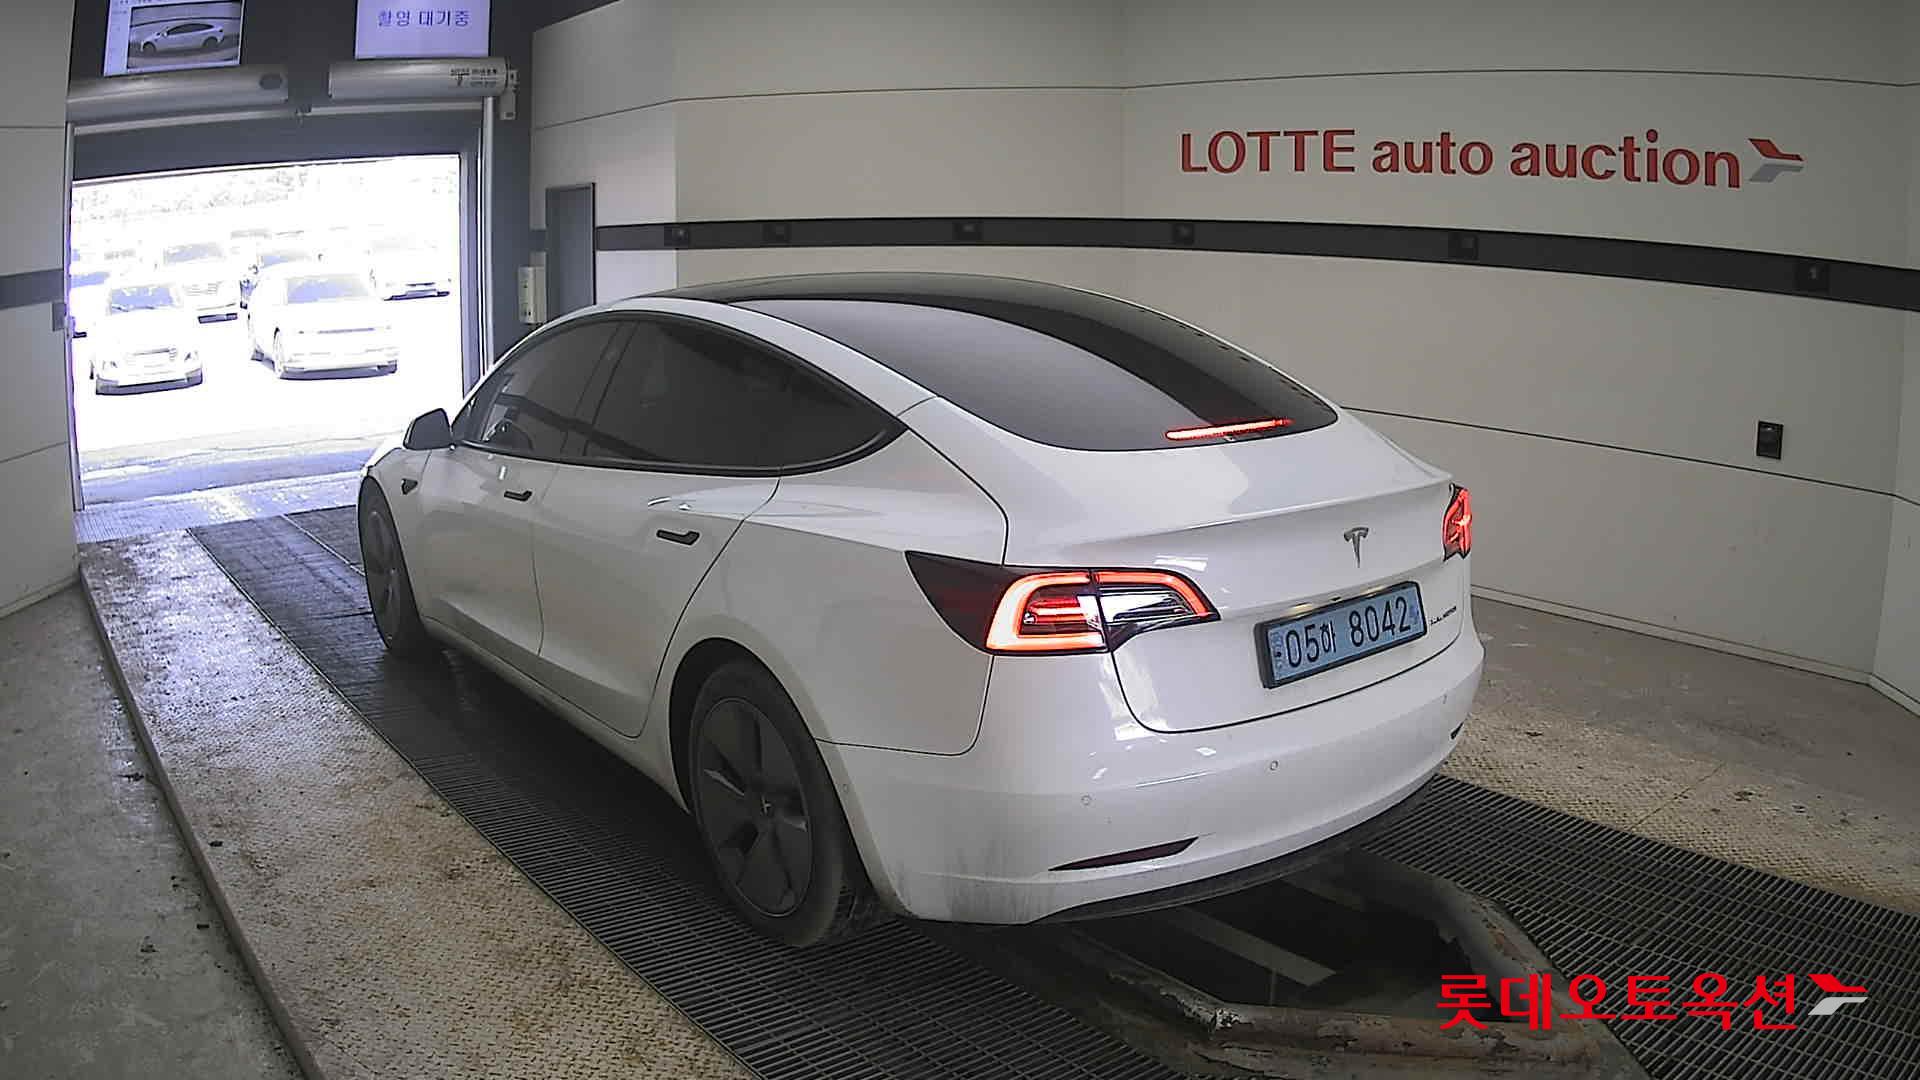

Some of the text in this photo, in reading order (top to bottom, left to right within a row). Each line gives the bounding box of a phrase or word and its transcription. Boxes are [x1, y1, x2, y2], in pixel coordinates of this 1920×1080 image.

[419, 9, 469, 27] 대기중
[1180, 128, 1742, 189] LOTTE auto auction
[1285, 620, 1337, 668] 05하
[1349, 596, 1411, 648] 8042
